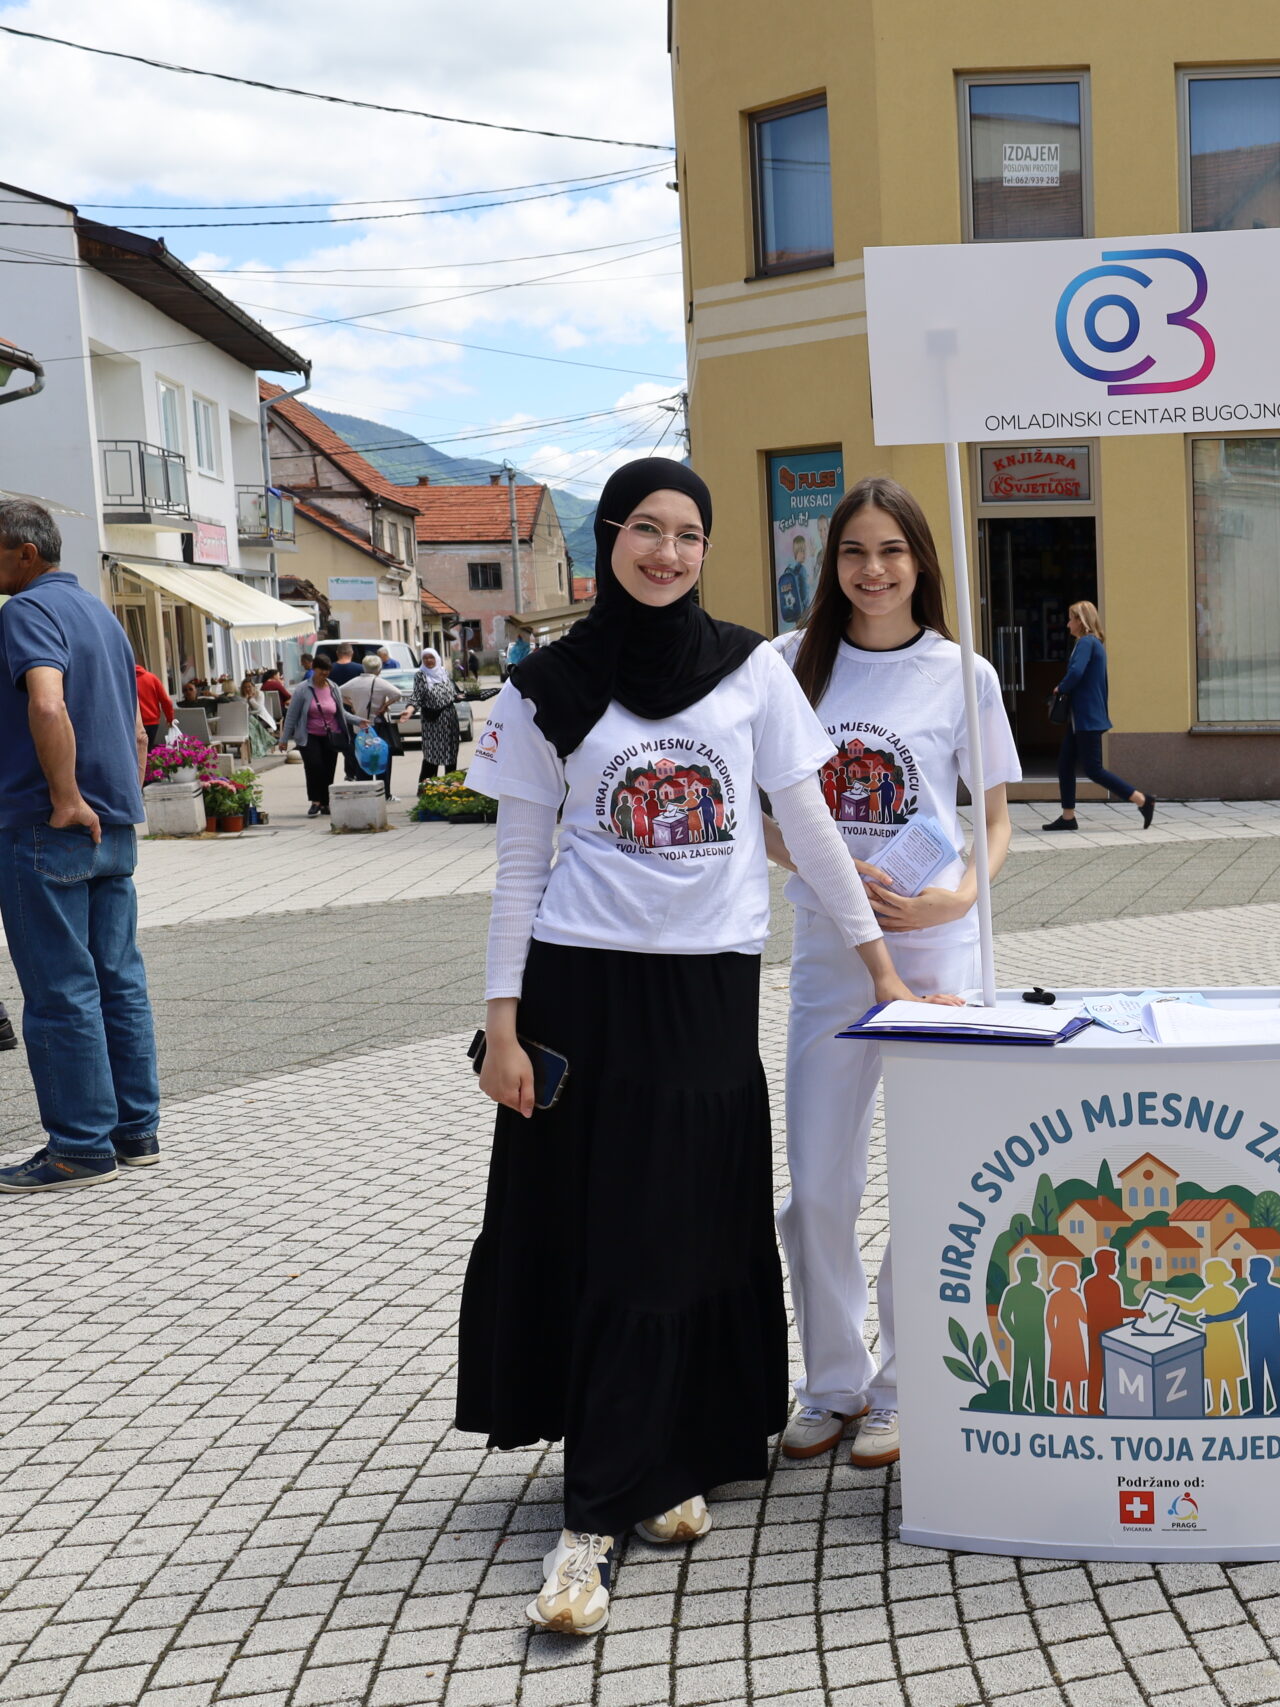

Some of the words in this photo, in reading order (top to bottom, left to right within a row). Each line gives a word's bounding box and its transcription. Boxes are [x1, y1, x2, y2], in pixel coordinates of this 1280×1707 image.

[1003, 146, 1059, 161] IZDAJEM
[1003, 164, 1032, 173] POSLOVNI
[1033, 164, 1058, 173] PROSTOR
[985, 411, 1102, 431] OMLADINSKI
[1108, 408, 1186, 426] CENTAR
[992, 448, 1077, 472] KNJIŽARA
[790, 494, 832, 509] RUKSACI
[778, 514, 796, 533] Feel
[840, 722, 888, 737] MJESNU
[886, 732, 920, 791] ZAJEDNICU
[595, 780, 610, 816] BIRAJ
[603, 745, 638, 780] SVOJU
[640, 738, 695, 753] MJESNU
[696, 743, 735, 804] ZAJEDNICU
[842, 826, 868, 836] TVOJA
[869, 828, 899, 838] ZAJEDN
[616, 843, 637, 854] TVOJ
[658, 851, 688, 861] TVOJA
[940, 1201, 986, 1305] BIRAJ
[970, 1108, 1073, 1203] SVOJU
[1080, 1091, 1244, 1141] MJESNU
[961, 1427, 1021, 1458] TVOJ
[1029, 1433, 1104, 1461] GLAS.
[1110, 1436, 1194, 1462] TVOJA
[1117, 1476, 1180, 1488] Podržano
[1184, 1476, 1205, 1488] od:
